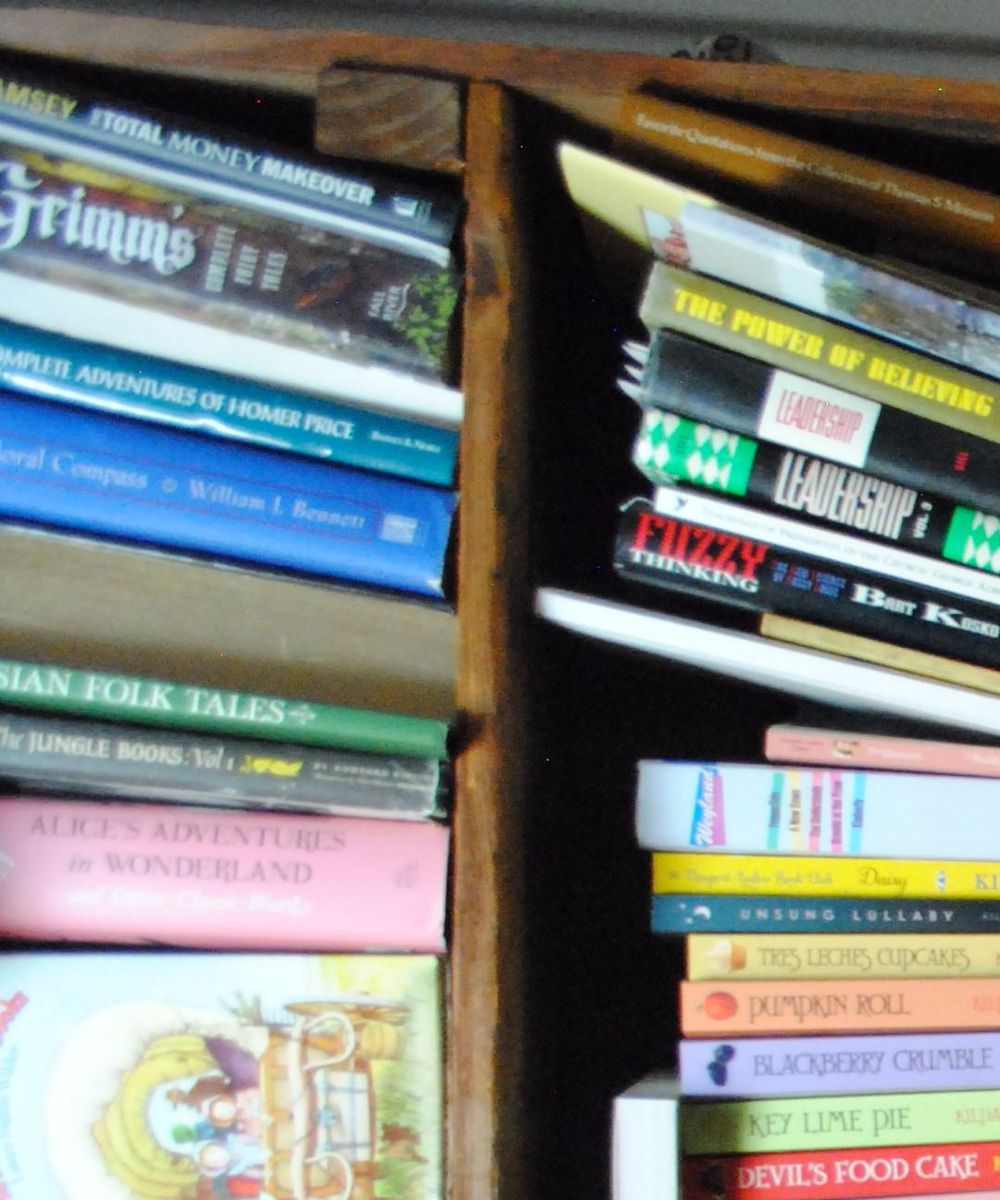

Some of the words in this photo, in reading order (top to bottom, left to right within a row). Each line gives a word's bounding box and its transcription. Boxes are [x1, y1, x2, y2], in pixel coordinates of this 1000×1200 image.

[103, 111, 163, 146] TOTAL
[164, 132, 262, 174] MONEY
[260, 156, 376, 207] MAKEOVER
[674, 288, 724, 326] THE
[731, 308, 823, 362] POWER
[828, 344, 866, 372] OF
[869, 356, 995, 418] BELIEVING
[75, 364, 197, 410] ADVENTURES
[200, 390, 227, 412] OF
[226, 397, 301, 431] HOMER
[302, 413, 354, 441] PRICE
[775, 389, 863, 445] LEADERSHIP
[51, 451, 148, 494] Compass
[188, 478, 274, 515] William
[293, 499, 366, 531] Bennett
[775, 451, 916, 540] LEADERSHIP
[633, 511, 768, 581] FUZZY
[628, 548, 758, 593] THINKING
[853, 584, 916, 617] BART
[921, 601, 1000, 639] KOSKO
[84, 677, 177, 712] FOLK
[185, 690, 287, 725] TALES
[29, 731, 110, 760] JUNGLE
[695, 765, 718, 848] Weyland
[30, 815, 142, 842] ALICE'S
[153, 818, 346, 851] ADVENTURES
[68, 852, 92, 874] in
[106, 853, 313, 886] WONDERLAND
[858, 865, 907, 891] Daisy
[740, 908, 836, 921] UNSUNG
[852, 909, 956, 922] LULLABY
[758, 946, 801, 972] TRES
[807, 946, 873, 972] LECHES
[876, 947, 972, 972] CUPCAKES
[748, 993, 848, 1024] PUMPKIN
[856, 993, 911, 1016] ROLL
[753, 1050, 886, 1077] BLACKBERRY
[893, 1048, 994, 1073] CRUMBLE
[748, 1113, 793, 1139] KEY
[803, 1109, 863, 1134] LIME
[873, 1107, 912, 1136] PIE
[738, 1162, 829, 1189] DEVIL'S
[834, 1157, 911, 1184] FOOD
[915, 1152, 979, 1178] CAKE
